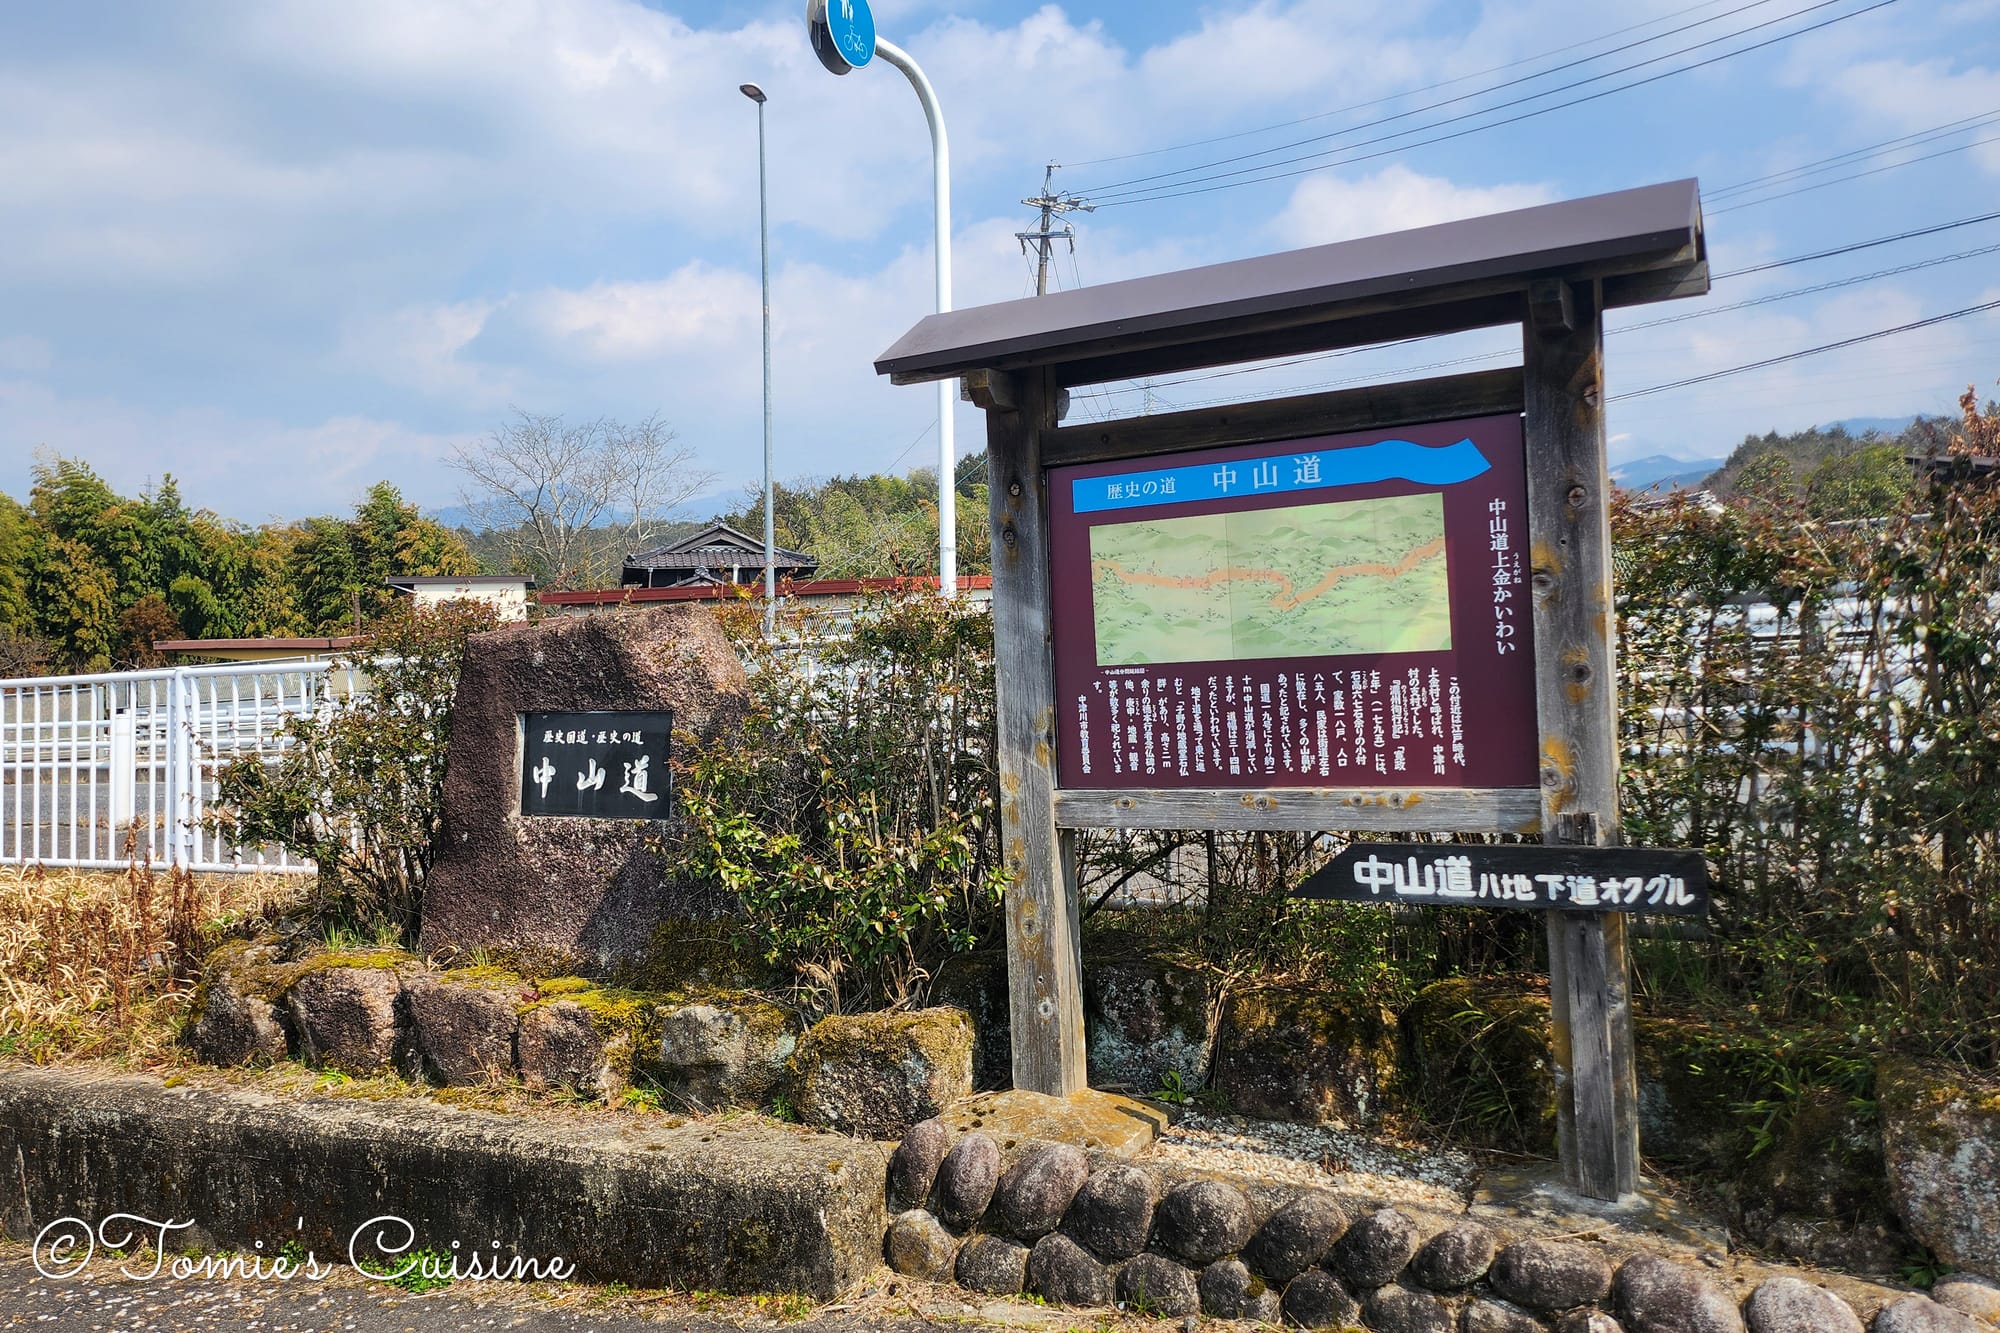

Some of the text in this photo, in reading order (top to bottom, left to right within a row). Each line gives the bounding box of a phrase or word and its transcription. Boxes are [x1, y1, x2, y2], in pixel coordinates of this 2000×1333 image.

[1107, 455, 1322, 500] 歴史の道 中山道
[1489, 498, 1515, 655] 中山道上金かいわい
[1512, 552, 1522, 584] うえがね
[1078, 695, 1092, 774] 中津川市教育委員会
[1208, 676, 1223, 771] だったといわれています。
[533, 754, 659, 802] 中山道
